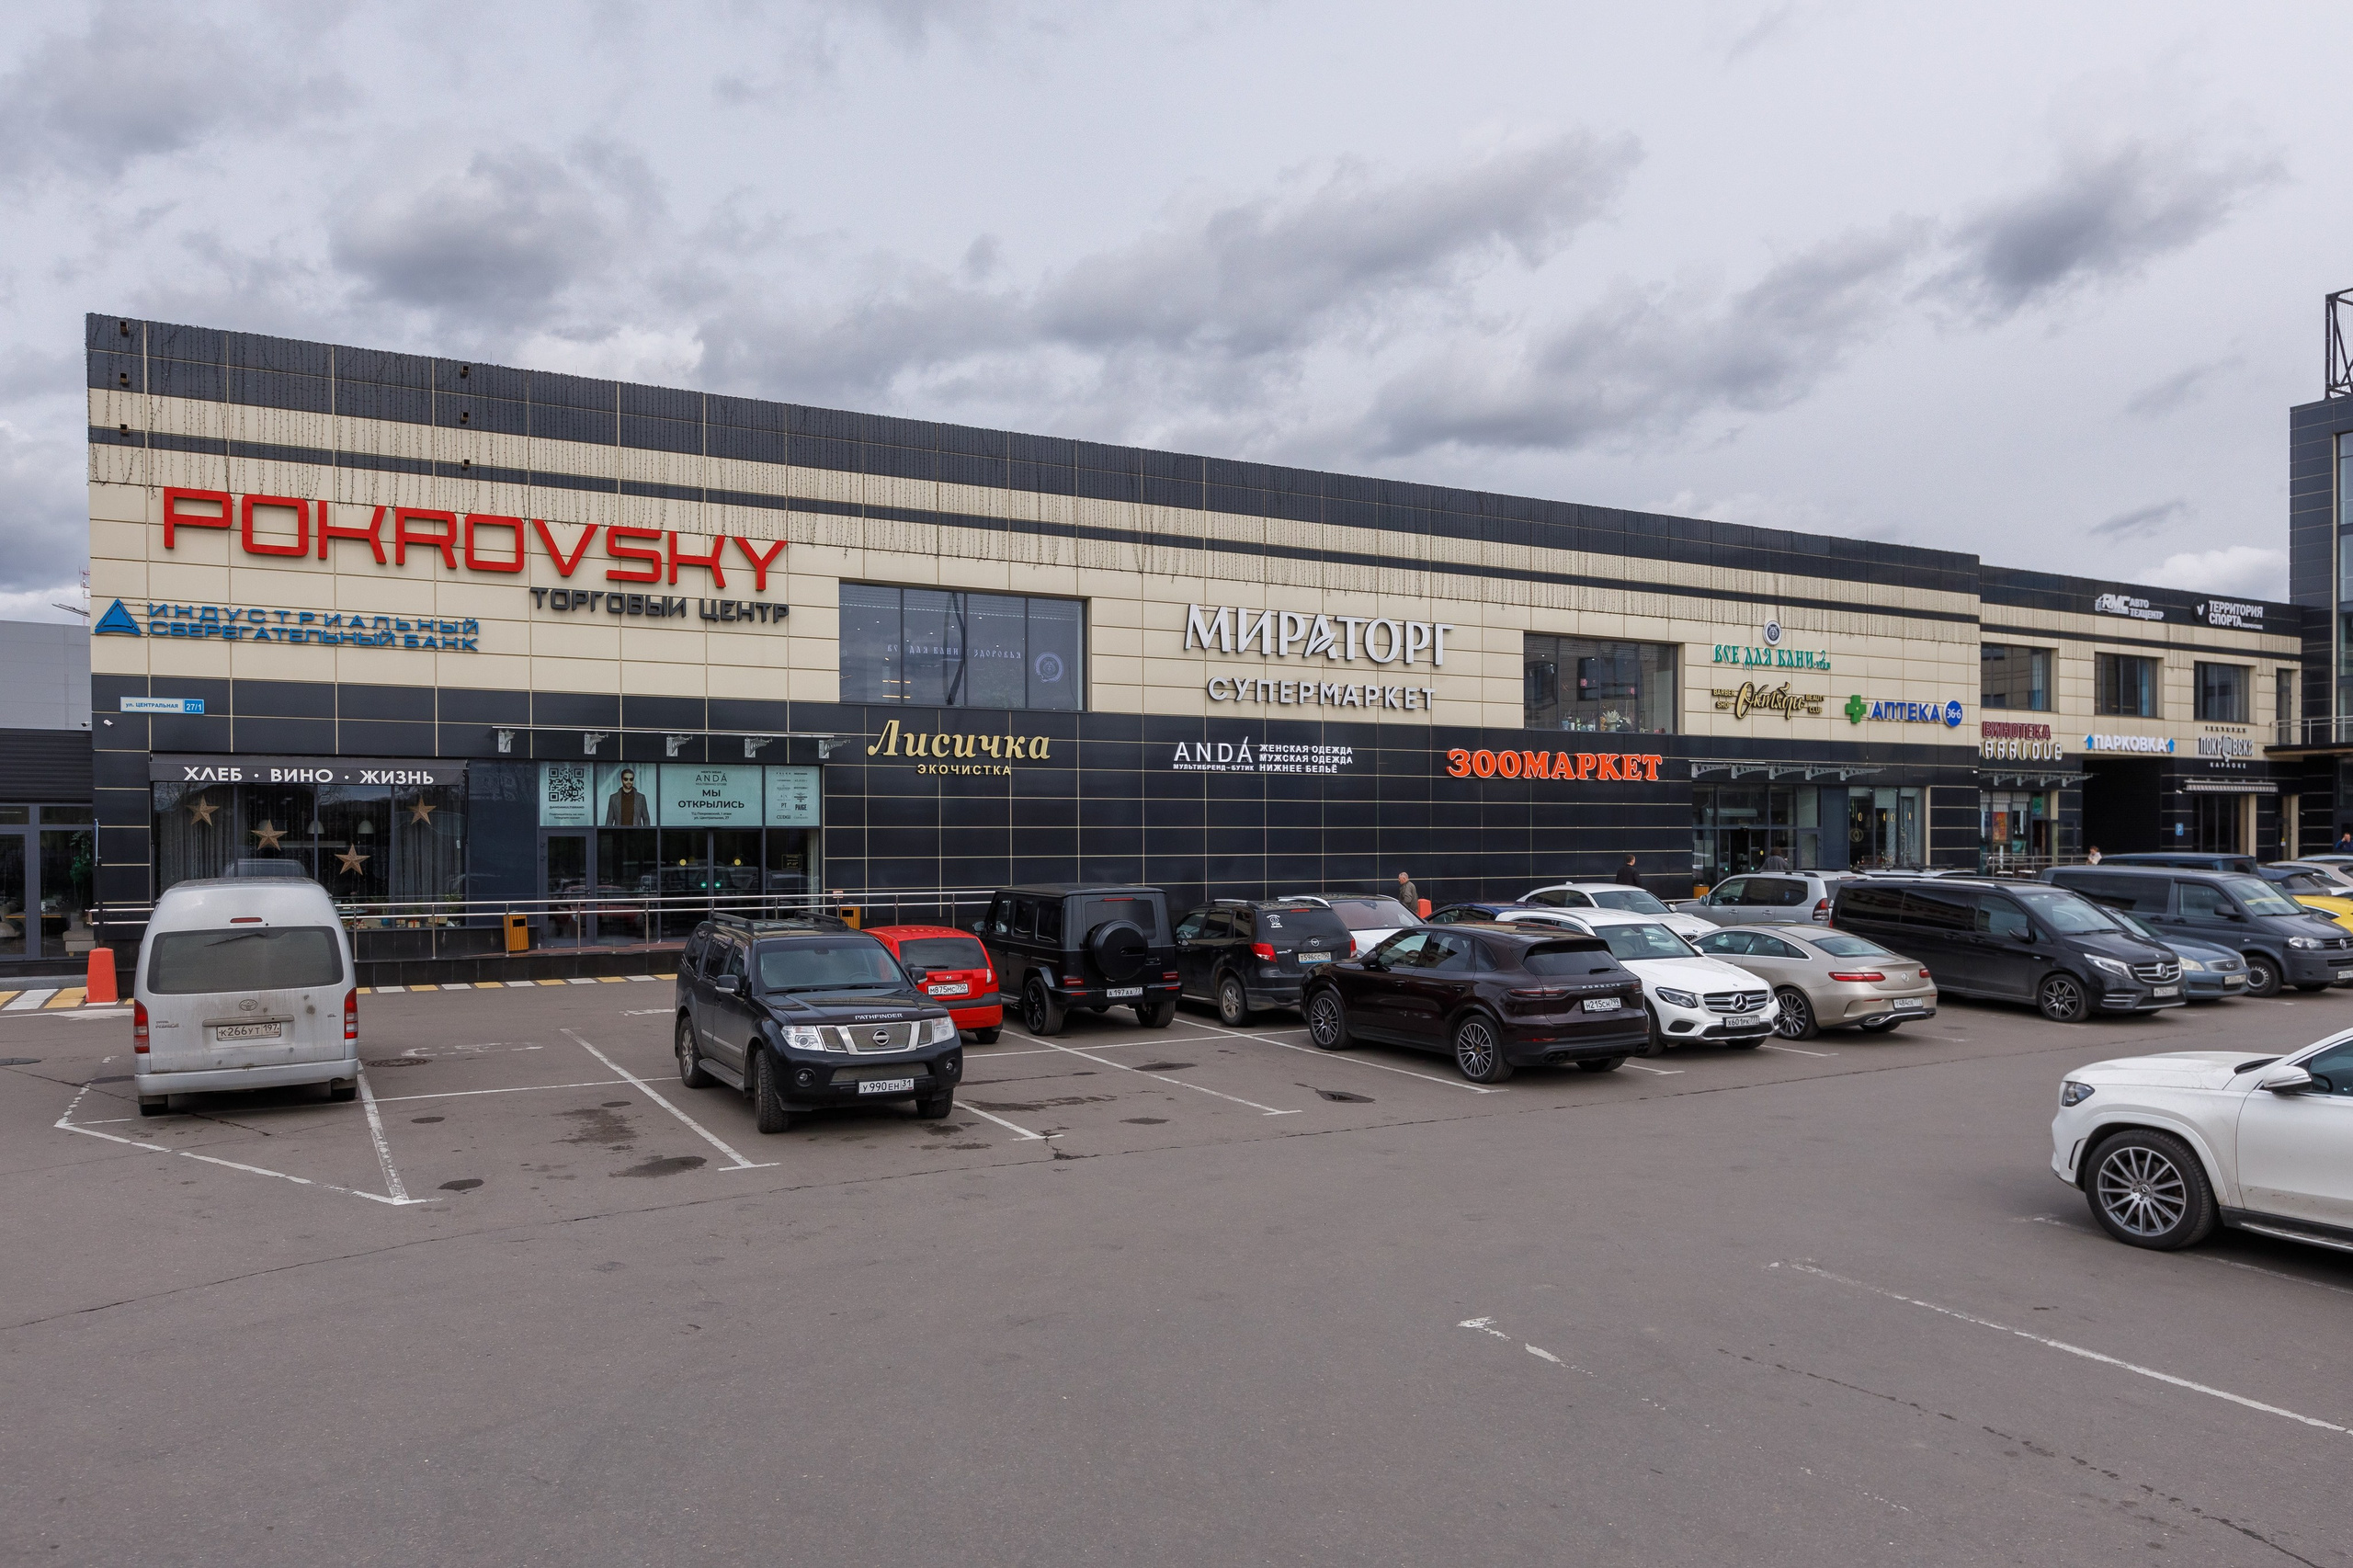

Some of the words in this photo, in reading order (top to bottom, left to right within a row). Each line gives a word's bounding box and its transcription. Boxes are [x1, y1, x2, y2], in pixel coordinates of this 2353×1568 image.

[164, 486, 789, 591] POKROVSKY
[699, 597, 790, 625] ЦЕНТР
[2130, 598, 2149, 608] АВТО
[2209, 600, 2264, 619] ТЕРРИТОРИЯ
[149, 602, 480, 634] ИНДУСТРИАЛЬНЫЙ
[2130, 608, 2165, 620] ТЕХЦЕНТР
[2209, 613, 2242, 628] СПОРТА
[149, 620, 396, 647] СБЕРЕГАТЕЛЬНЫЙ
[404, 634, 479, 652] БАНК
[1185, 603, 1454, 666] МИРАТОРГ
[887, 644, 899, 653] ВС
[974, 649, 1022, 659] ЗДОРОВЬЯ
[1713, 643, 1740, 664] ВСЕ
[1743, 646, 1773, 670] ДЛЯ
[1776, 649, 1814, 669] БАНИ
[1208, 676, 1437, 711] СУПЕРМАРКЕТ
[186, 703, 202, 711] 27/1
[1870, 700, 1941, 722] АПТЕКА
[867, 719, 1051, 760] Лисичка
[1982, 721, 2052, 740] ВИНОТЕКА
[1174, 736, 1253, 763] ANDÁ
[1258, 744, 1309, 753] ЖЕНСКАЯ
[1312, 745, 1353, 755] ОДЕЖДА
[2094, 734, 2168, 752] ПАРКОВКА
[1258, 754, 1309, 763] МУЖСКАЯ
[1312, 755, 1353, 765] ОДЕЖДА
[1259, 764, 1302, 773] НИЖНЕЕ
[1305, 764, 1338, 773] БЕЛЬЁ
[1446, 747, 1663, 782] ЗООМАРКЕТ
[184, 766, 243, 782] ХЛЕБ
[270, 768, 334, 783] ВИНО
[359, 769, 434, 785] ЖИЗНЬ
[696, 773, 727, 782] ANDÁ
[917, 763, 1011, 776] ЭКОЧИСТКА
[221, 1026, 260, 1037] К266УТ
[862, 1082, 900, 1092] У990ЕН
